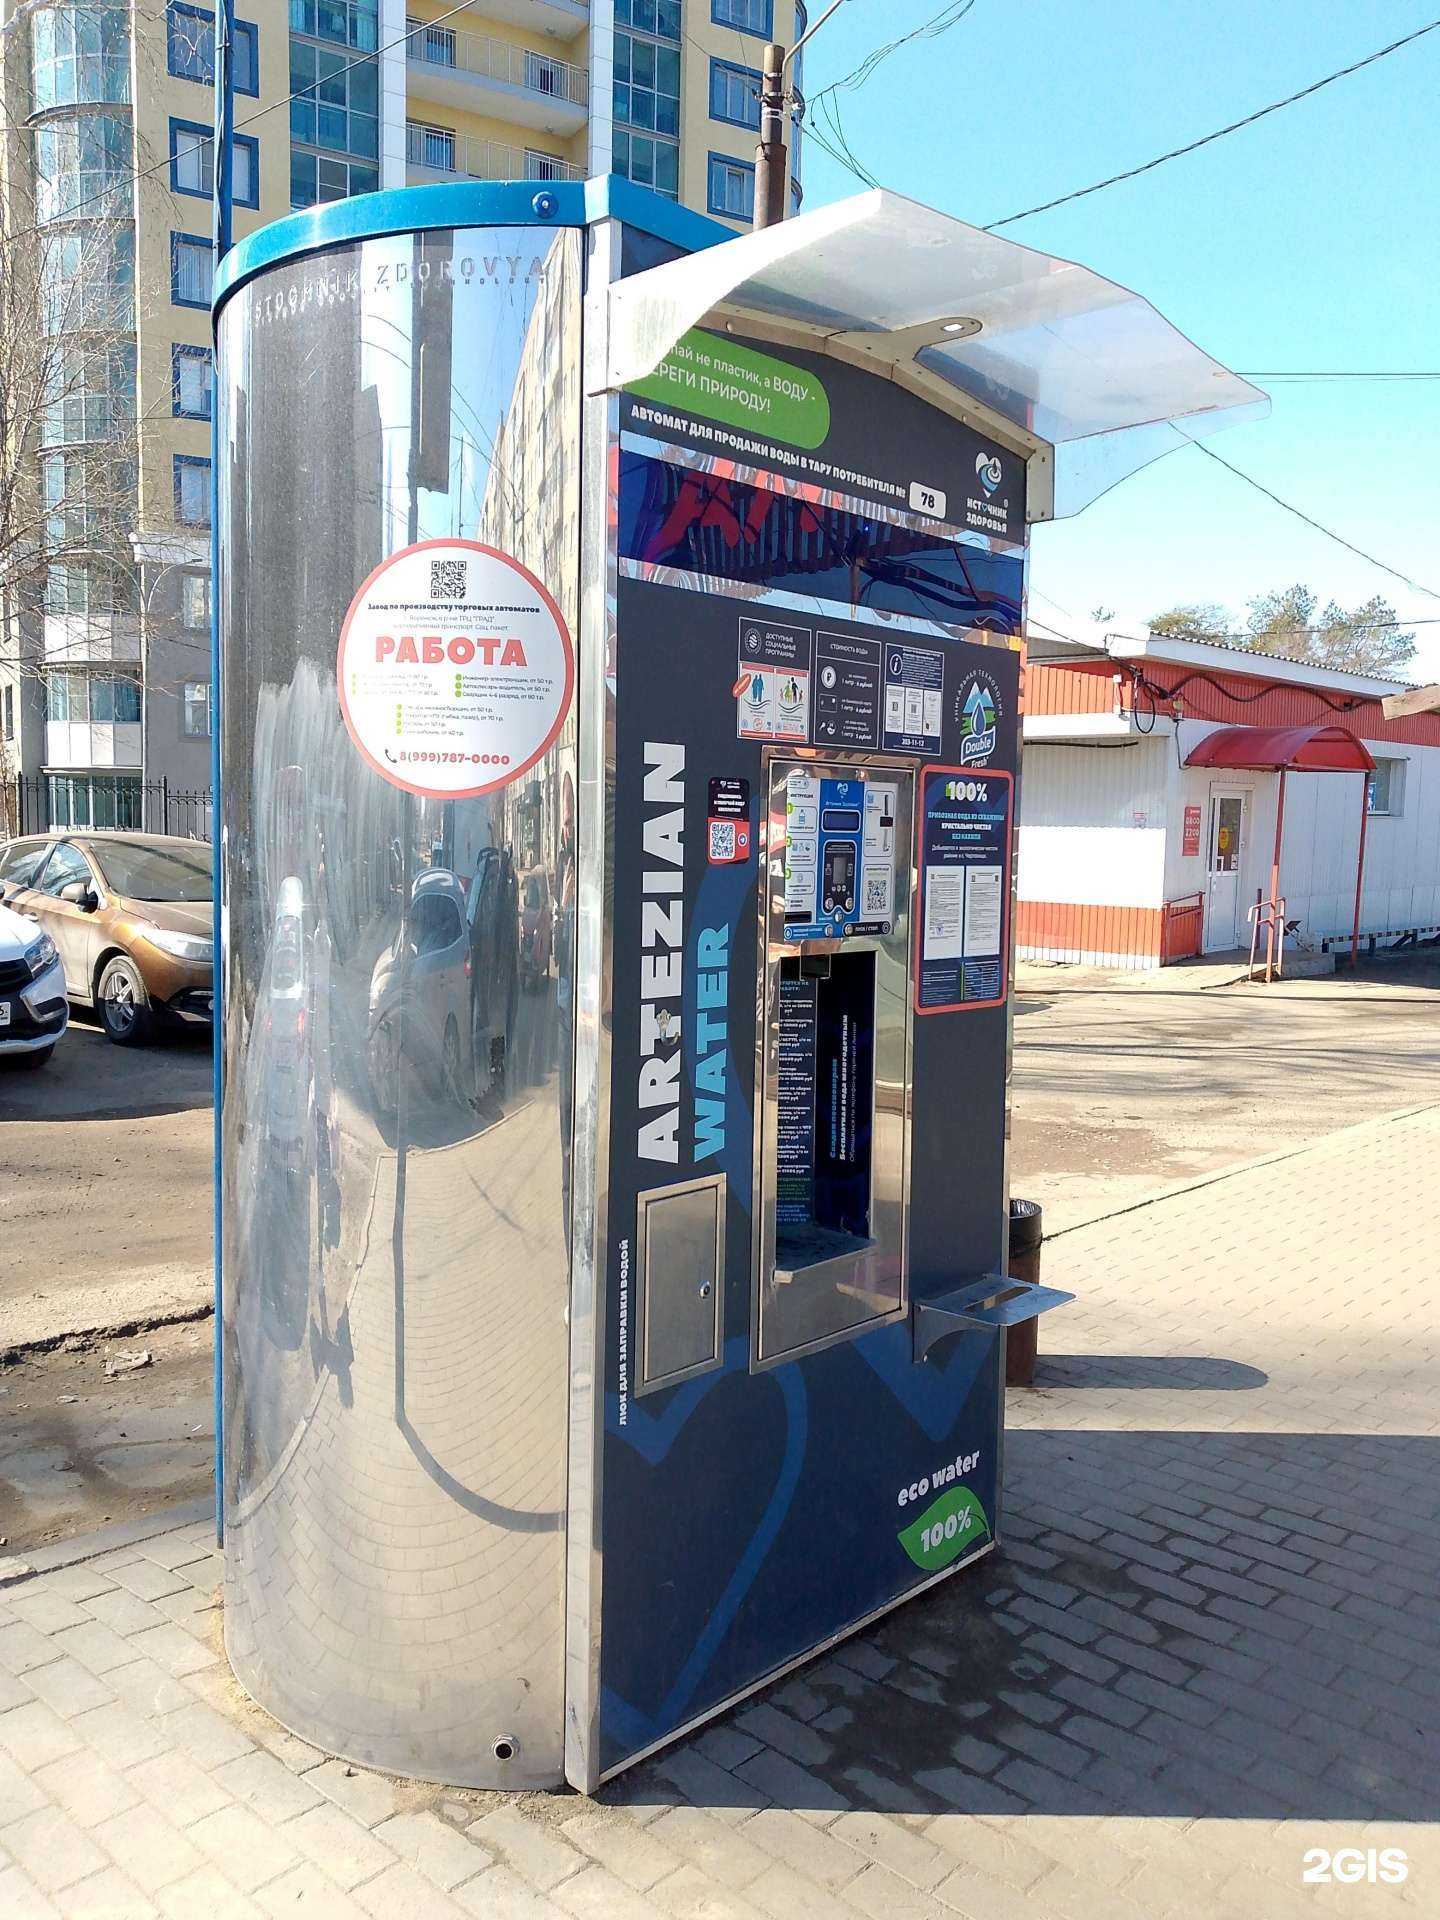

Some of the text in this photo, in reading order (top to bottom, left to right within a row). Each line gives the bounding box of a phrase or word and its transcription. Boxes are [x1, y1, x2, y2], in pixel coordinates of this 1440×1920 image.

[376, 256, 545, 285] ZDOROVYA
[696, 353, 710, 365] не
[713, 359, 762, 386] пластик,
[764, 378, 770, 388] а
[773, 376, 808, 401] ВОДУ
[700, 375, 772, 413] ПРИРОДУ!
[631, 404, 906, 499] АВТОМАТ ДЛЯ ПРОДАЖИ ВОДЫ В ТАРУ ПОТРЕБИТЕЛЯ №
[920, 491, 935, 509] 78
[965, 512, 1007, 534] ЗДОРОВЬЯ
[400, 604, 453, 612] производству
[454, 604, 493, 612] торговых
[495, 605, 540, 613] автоматов
[376, 636, 528, 666] РАБОТА
[400, 751, 510, 765] 8(999)787-0000
[965, 737, 991, 754] Double
[971, 756, 989, 768] Fresh
[947, 781, 987, 802] 100%
[637, 741, 685, 1165] ARTEZIAN
[694, 922, 729, 1163] WATER
[619, 1239, 629, 1426] ЛЮК ДЛЯ ЗАПРАВКИ ВОДОЙ
[897, 1450, 980, 1507] eco water
[920, 1505, 972, 1553] 100%
